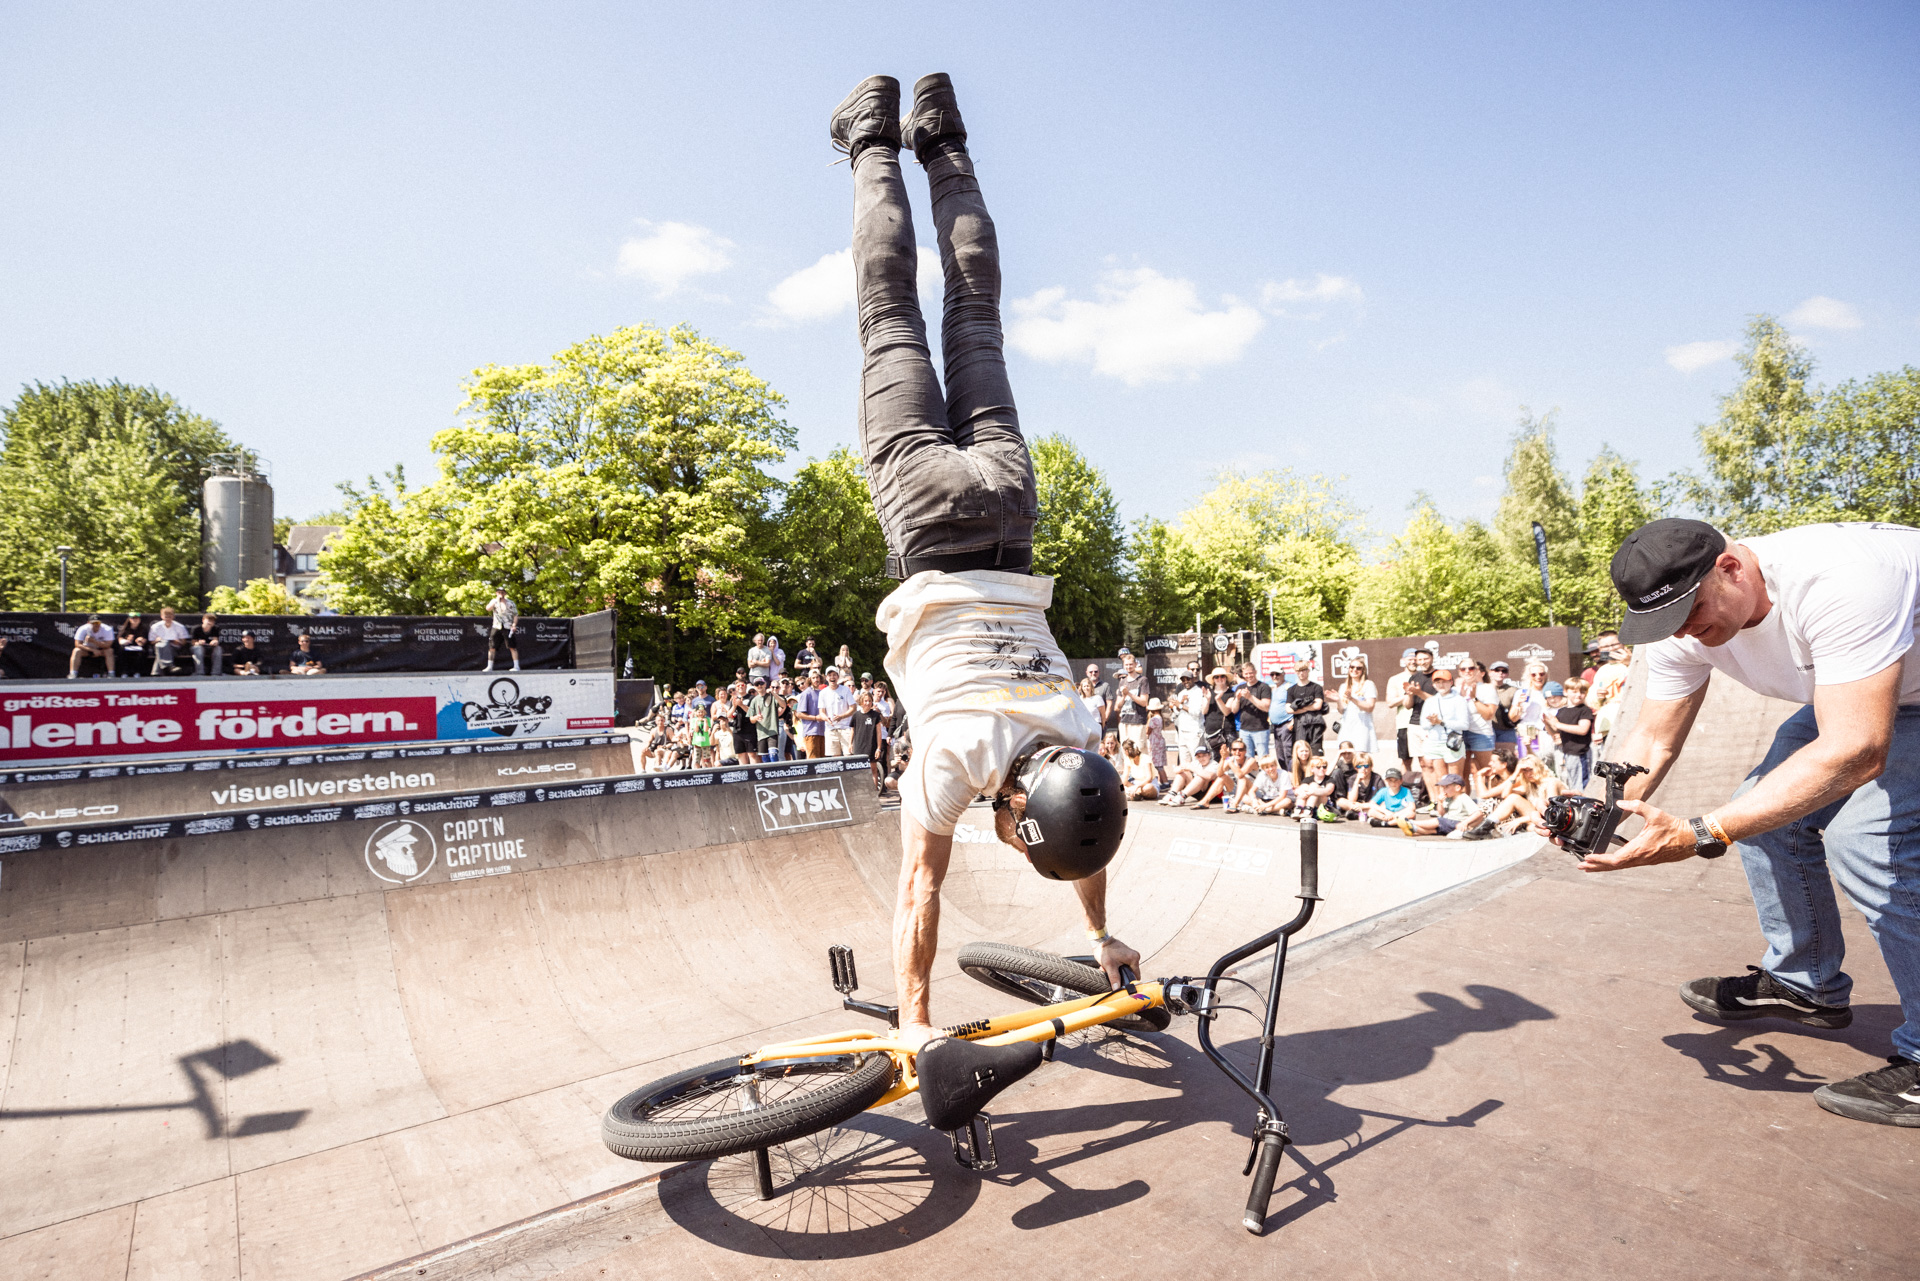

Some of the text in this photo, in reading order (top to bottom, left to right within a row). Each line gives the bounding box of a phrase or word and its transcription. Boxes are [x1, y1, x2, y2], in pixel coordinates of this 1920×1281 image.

[417, 634, 460, 642] FLENSBURG
[3, 695, 100, 712] größtes
[0, 706, 418, 750] lente fördern.
[211, 771, 436, 805] visuellverstehen
[779, 788, 844, 816] JYSK
[443, 816, 505, 842] CAPT'N
[445, 838, 528, 868] CAPTURE
